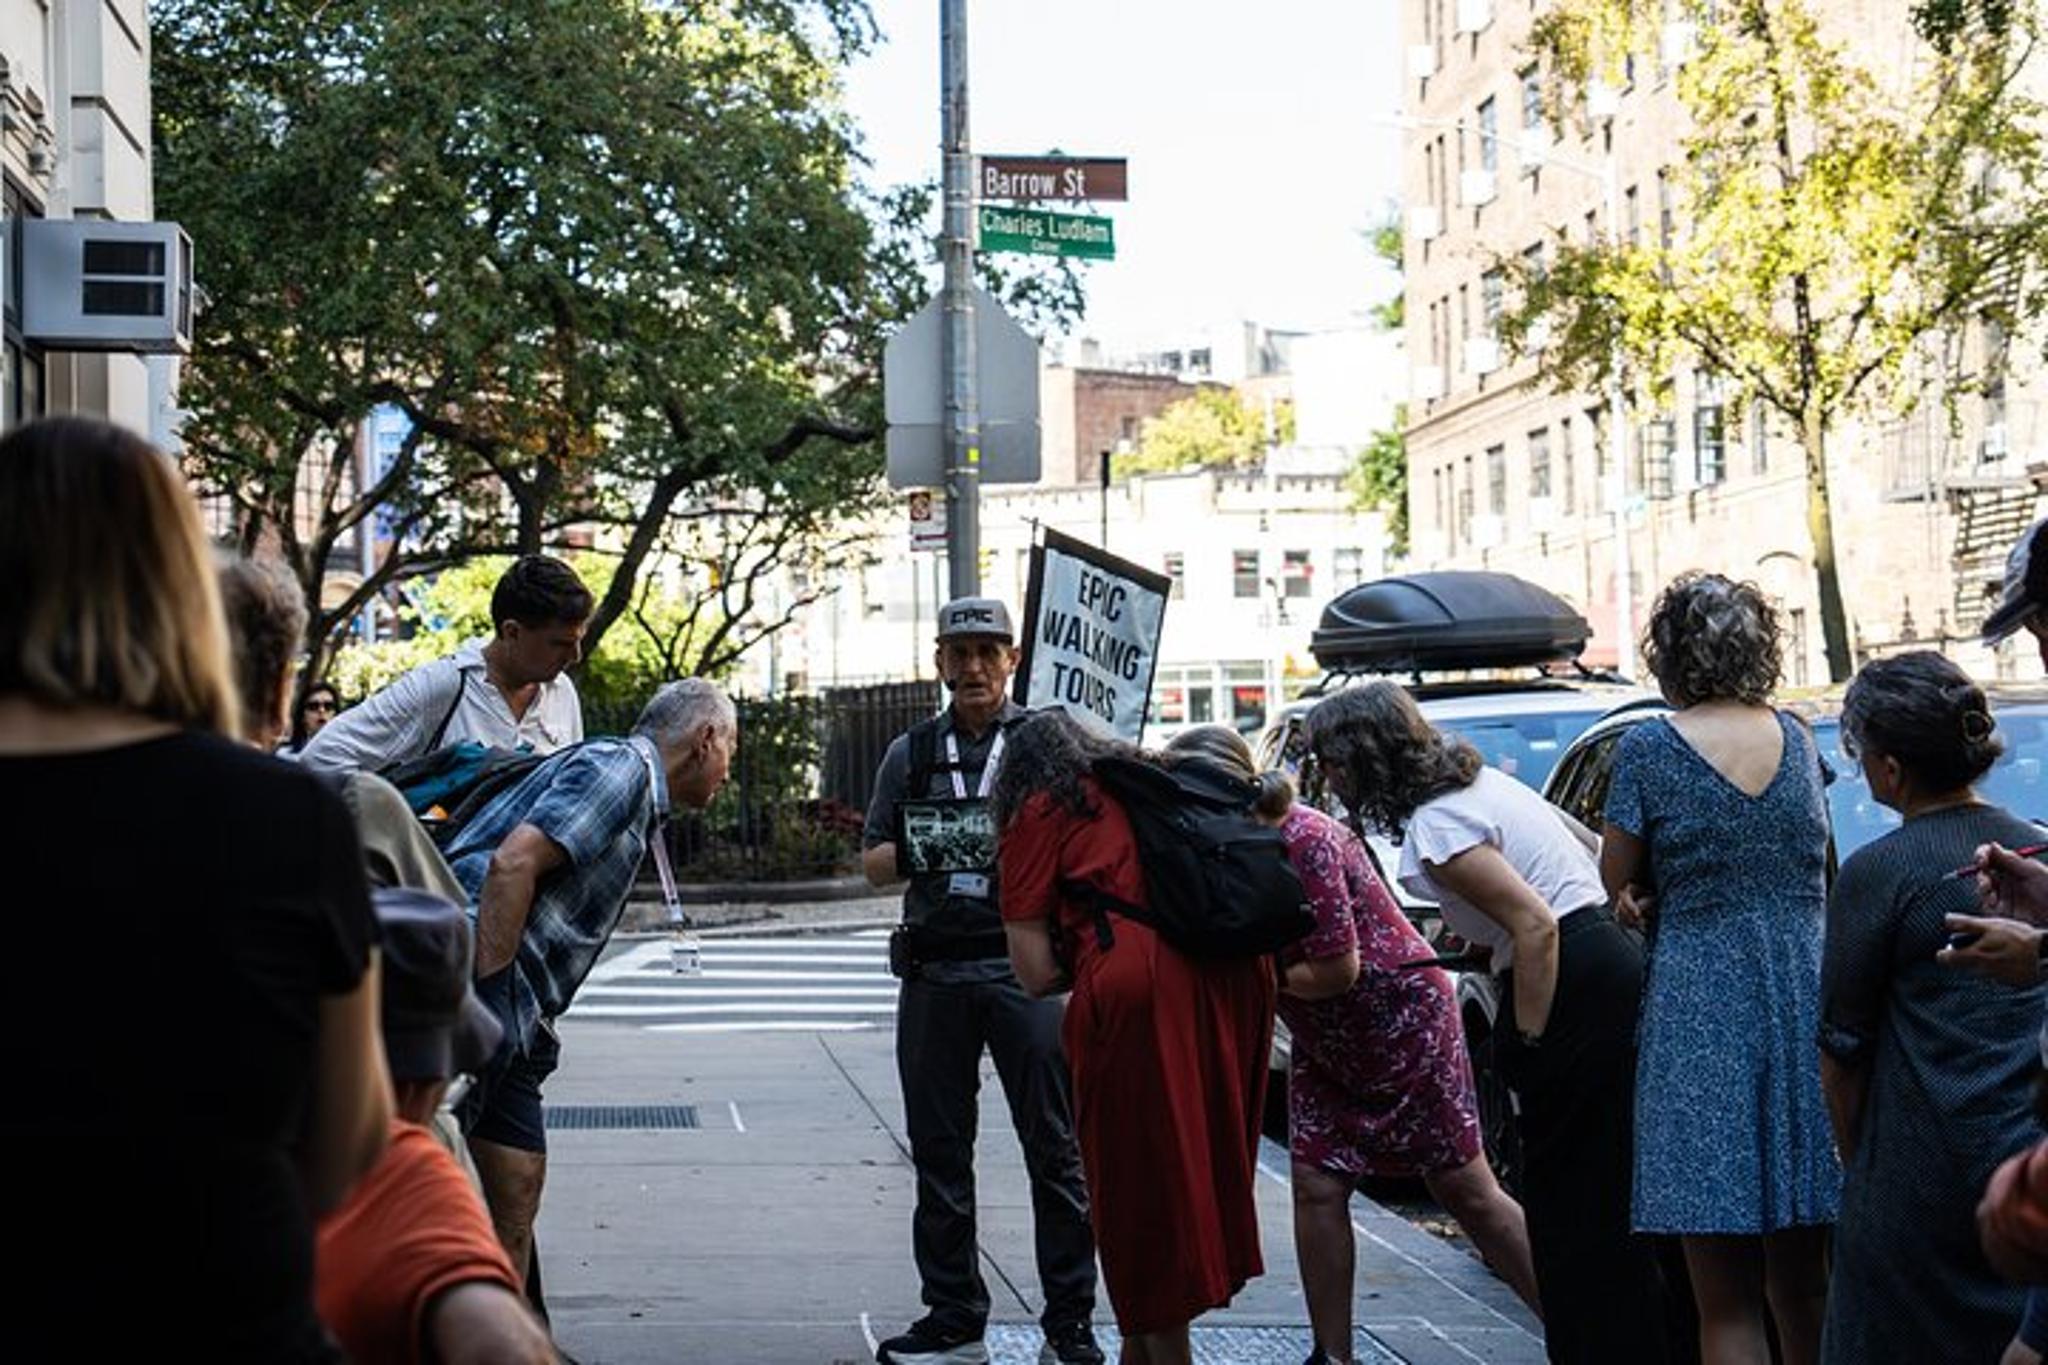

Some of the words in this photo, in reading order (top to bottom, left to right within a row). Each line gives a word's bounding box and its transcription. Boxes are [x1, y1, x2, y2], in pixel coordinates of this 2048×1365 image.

[986, 167, 1056, 196] Barrow
[1063, 168, 1085, 196] St
[982, 209, 1044, 237] Charles
[1049, 216, 1110, 242] Ludlam
[1077, 570, 1127, 622] EPIC
[1043, 608, 1142, 681] WALKING
[1052, 661, 1116, 723] TOURS
